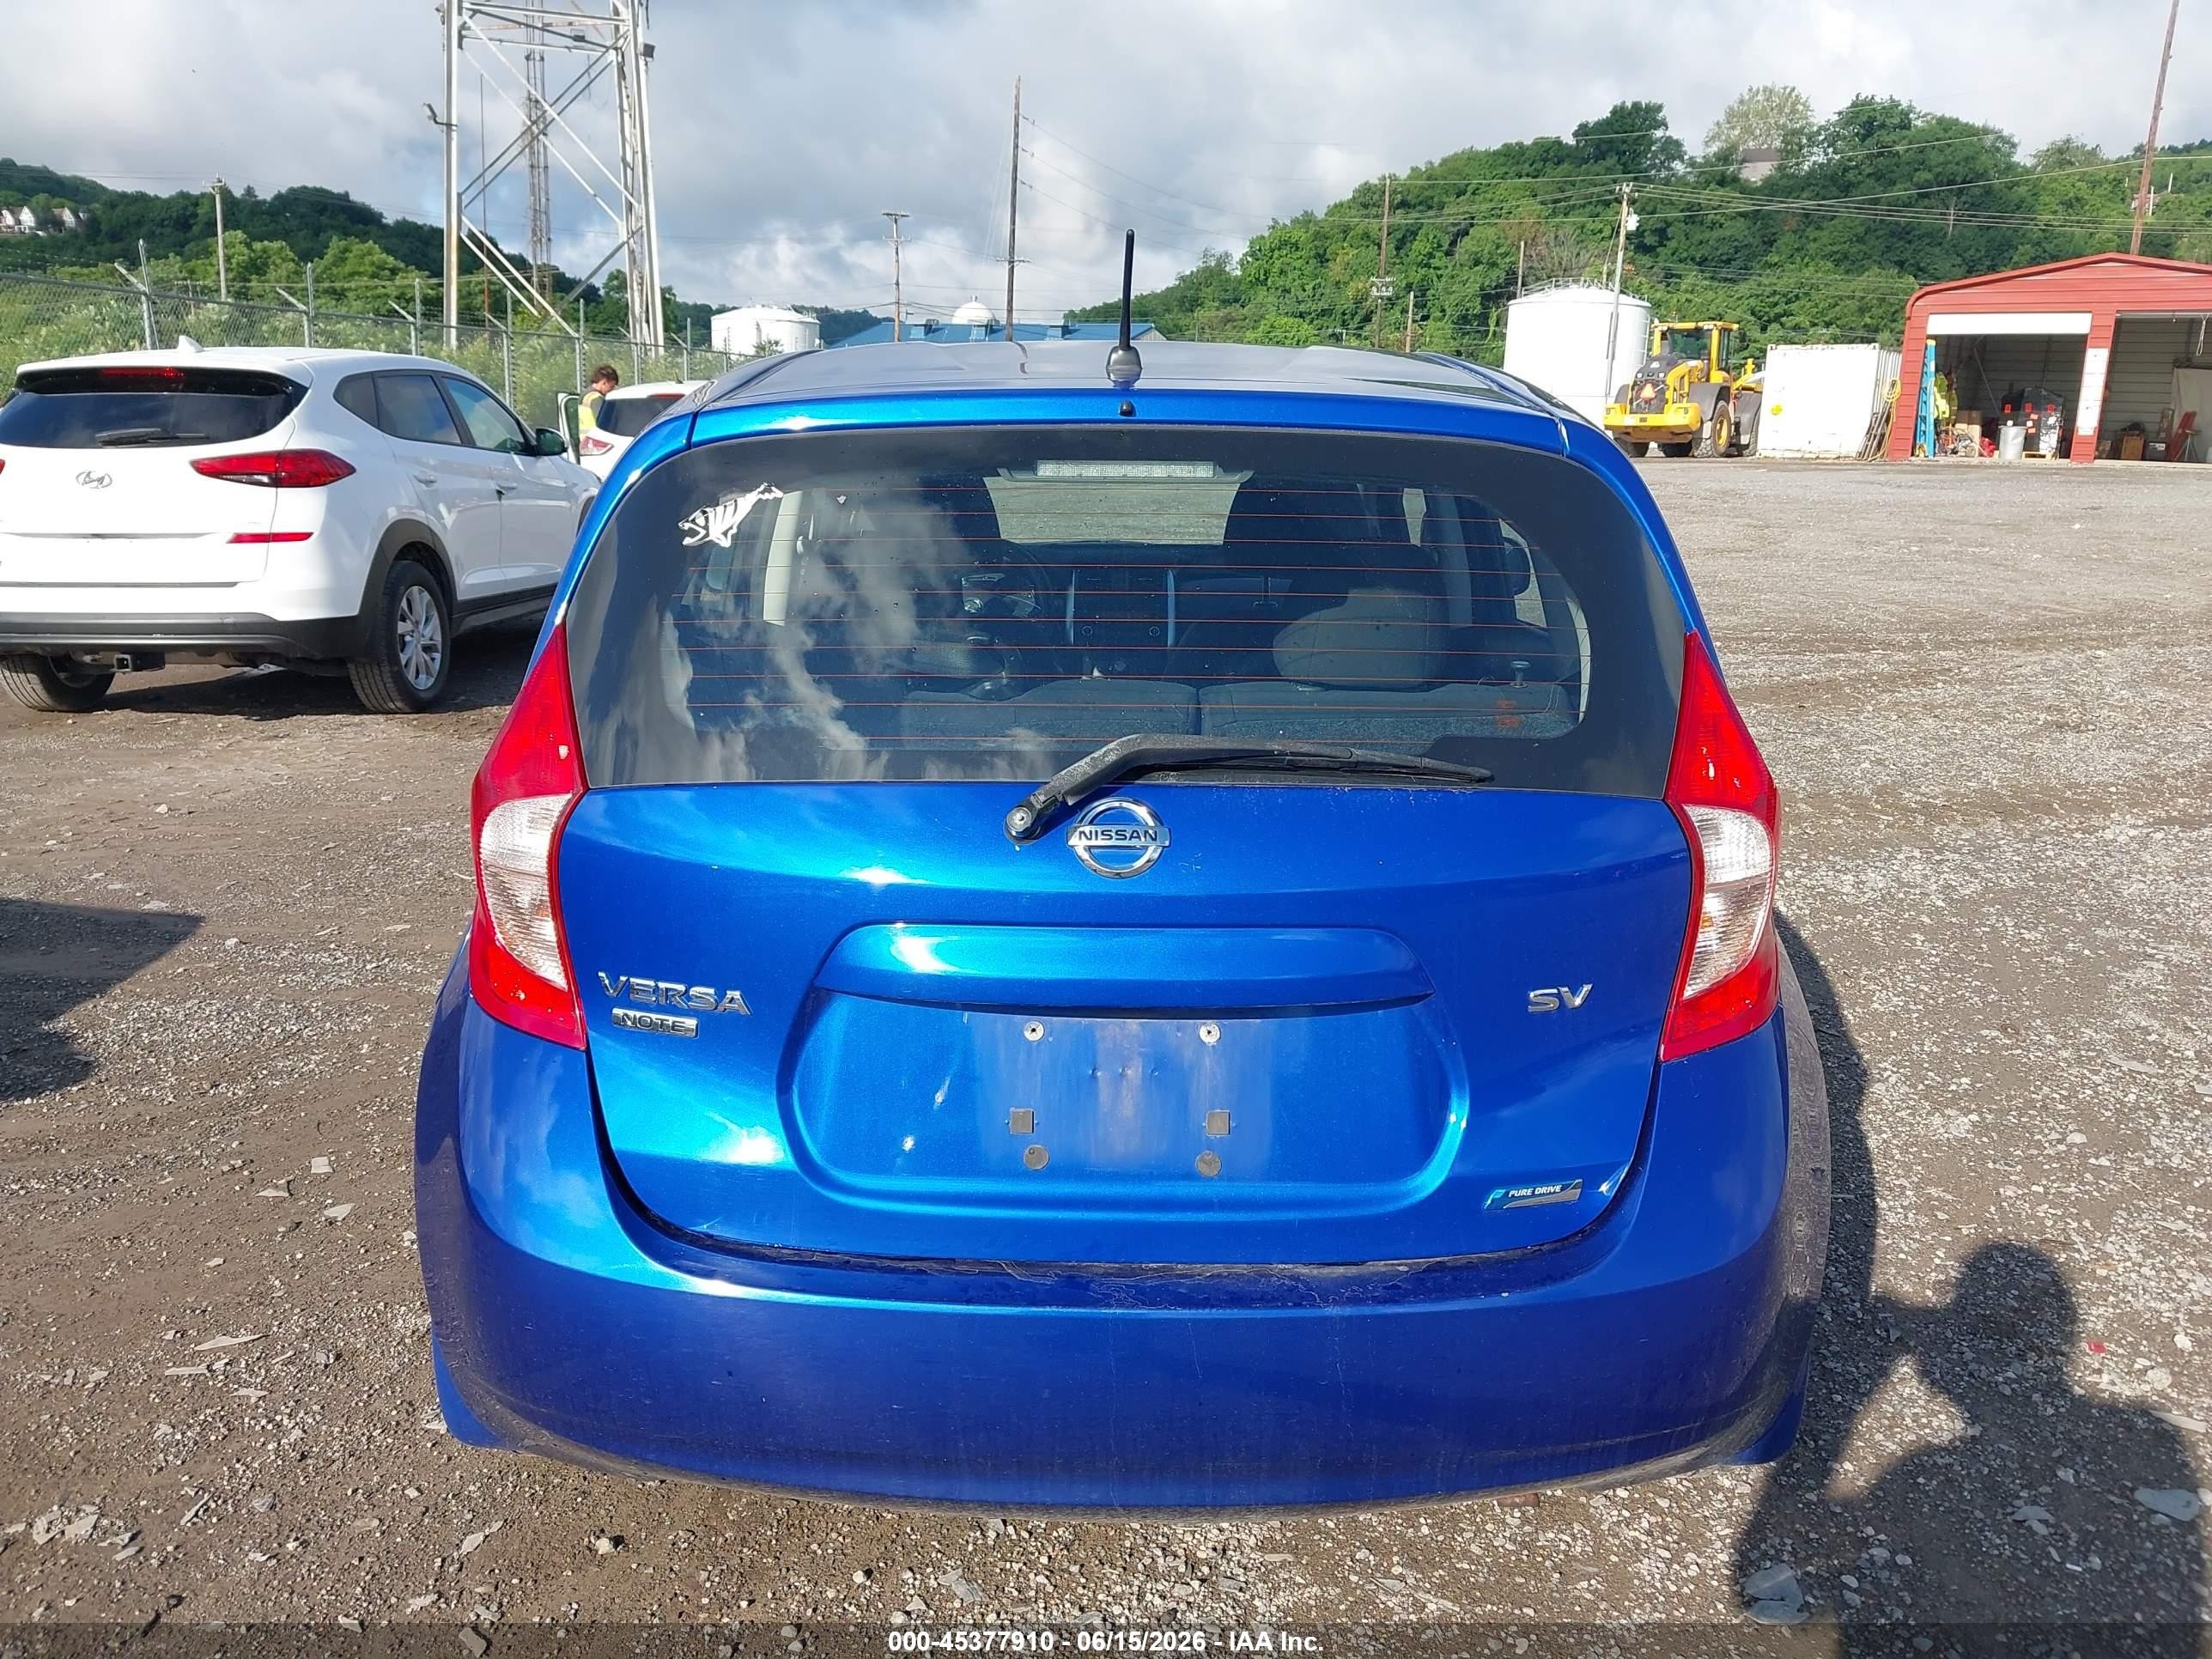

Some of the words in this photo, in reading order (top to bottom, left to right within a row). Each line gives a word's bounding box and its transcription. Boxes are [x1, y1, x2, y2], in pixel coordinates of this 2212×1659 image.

[1077, 829, 1158, 842] NISSAN
[597, 970, 752, 1016] VERSA
[1528, 982, 1594, 1012] SV
[620, 1012, 688, 1034] NOTE
[1508, 1188, 1534, 1198] PURE
[1534, 1184, 1563, 1194] DRIVE
